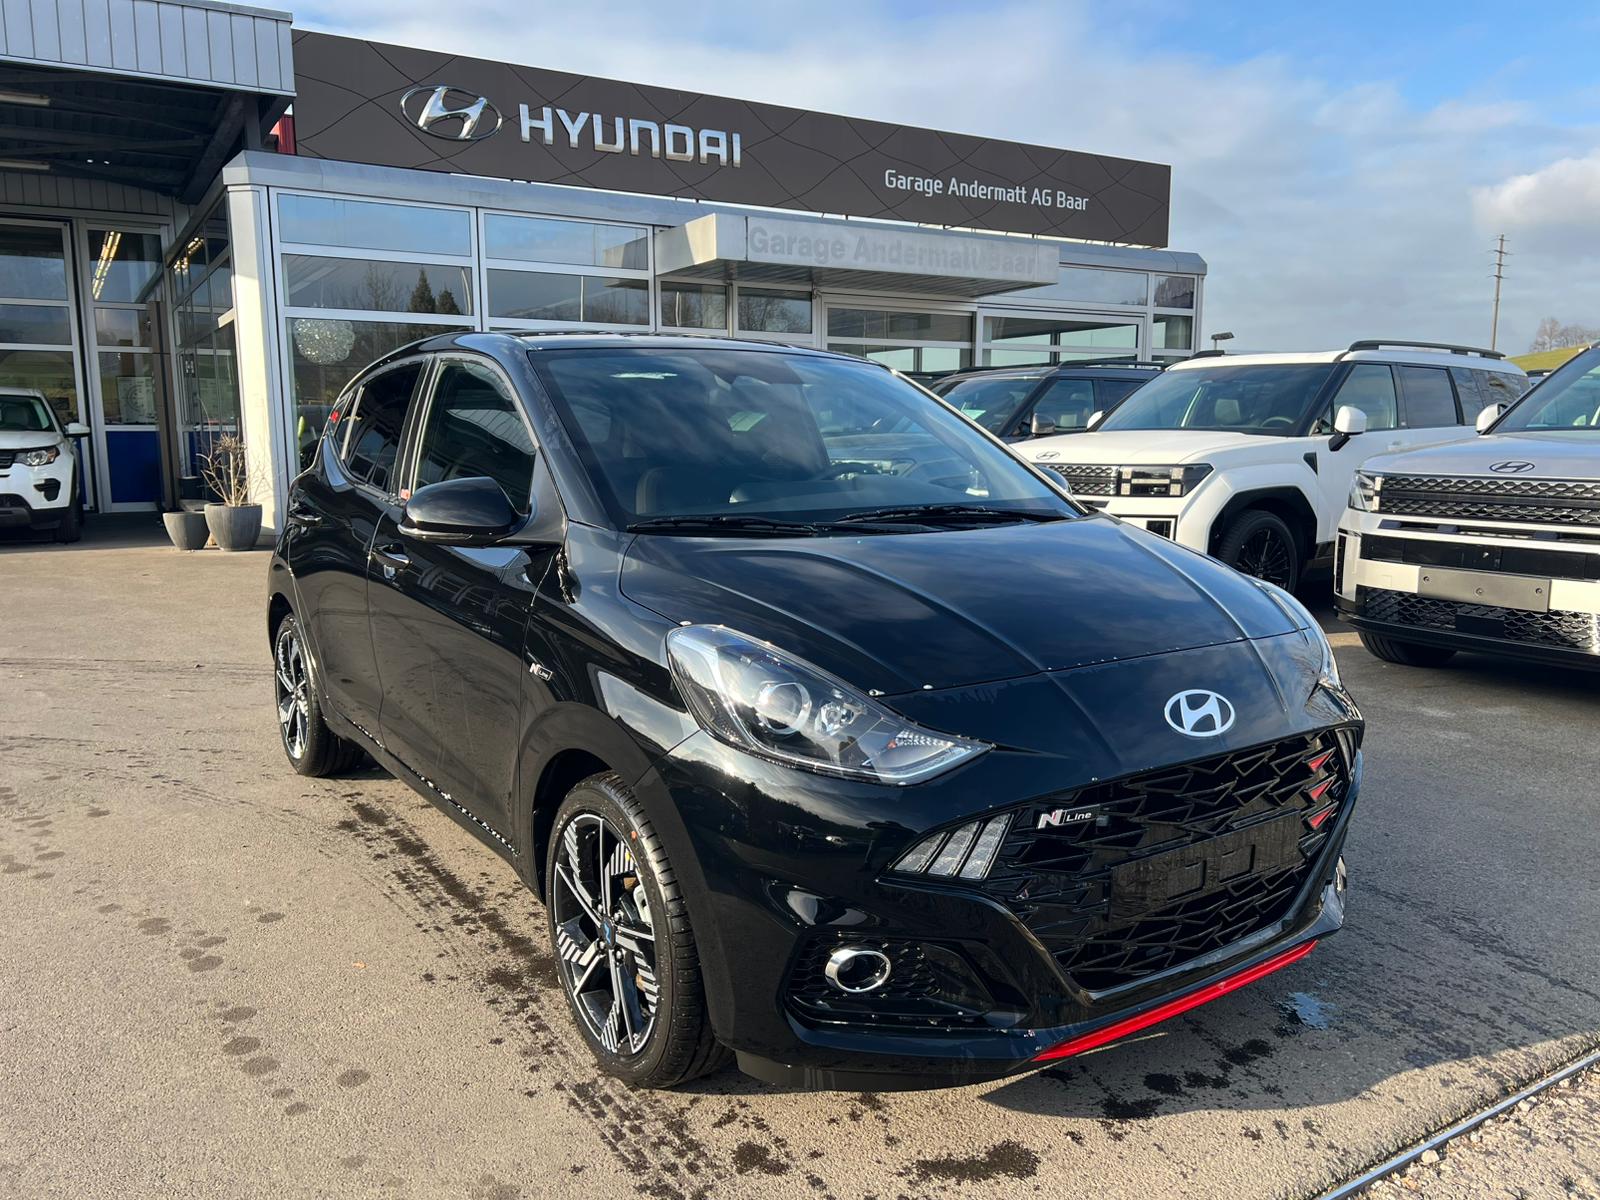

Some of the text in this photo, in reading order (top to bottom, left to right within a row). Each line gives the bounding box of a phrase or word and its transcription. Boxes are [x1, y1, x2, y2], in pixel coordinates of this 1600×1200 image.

[518, 103, 741, 168] HYUNDAI
[884, 169, 1089, 211] Garage Andermatt AG Baar
[750, 226, 846, 263] Garage
[1037, 809, 1092, 829] N Line
